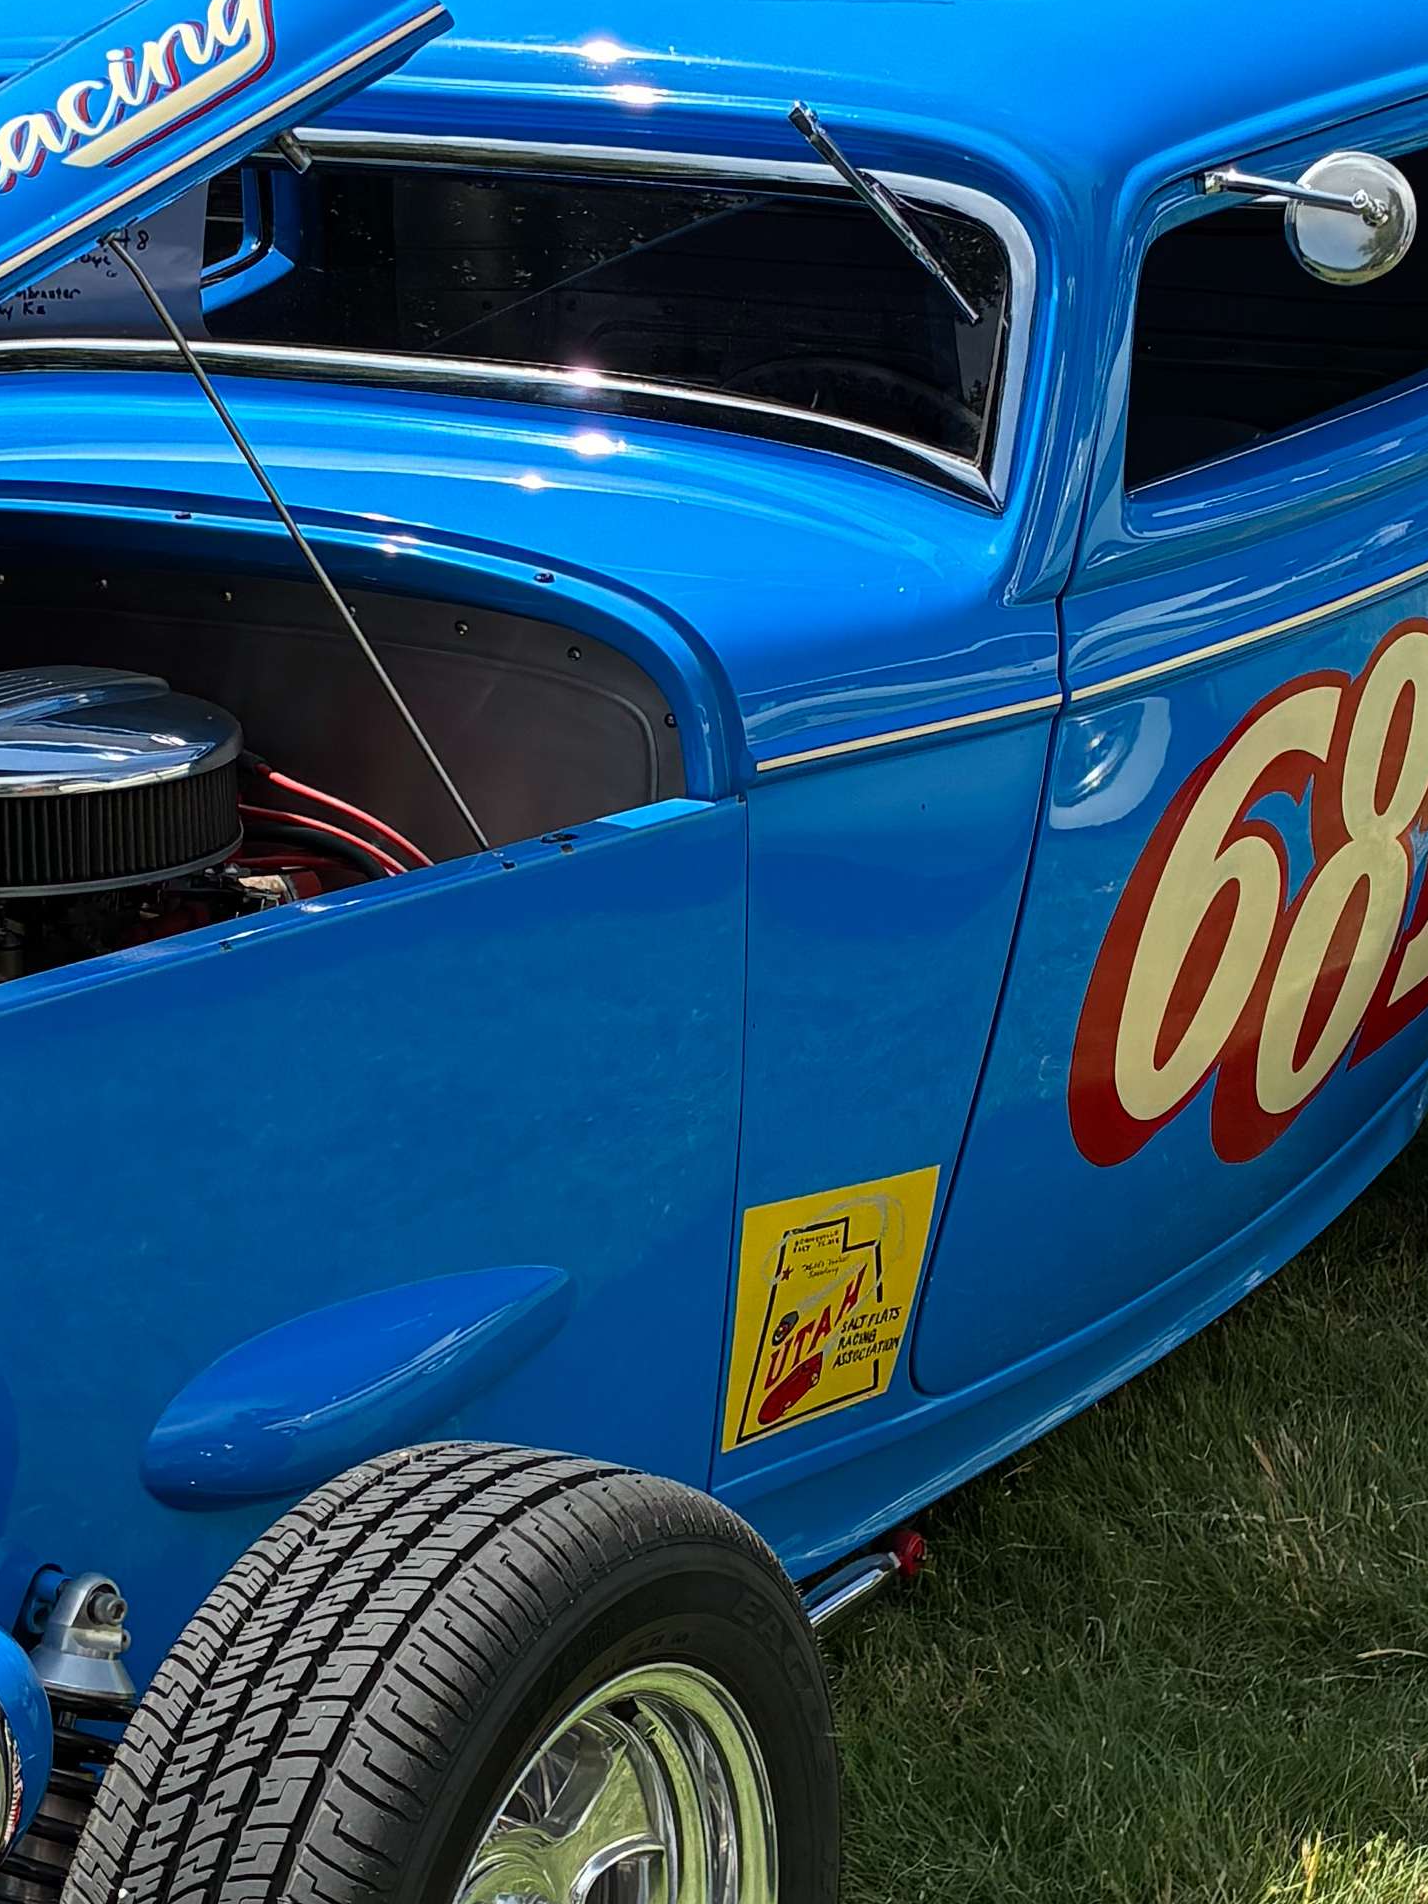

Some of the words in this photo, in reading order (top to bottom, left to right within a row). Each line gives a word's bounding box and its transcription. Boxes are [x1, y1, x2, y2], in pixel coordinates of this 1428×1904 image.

[764, 1263, 867, 1390] UTAH
[840, 1315, 867, 1334] SALT
[866, 1306, 902, 1328] FLATS
[831, 1336, 900, 1370] ASSOCIATION
[837, 1328, 877, 1351] RACING
